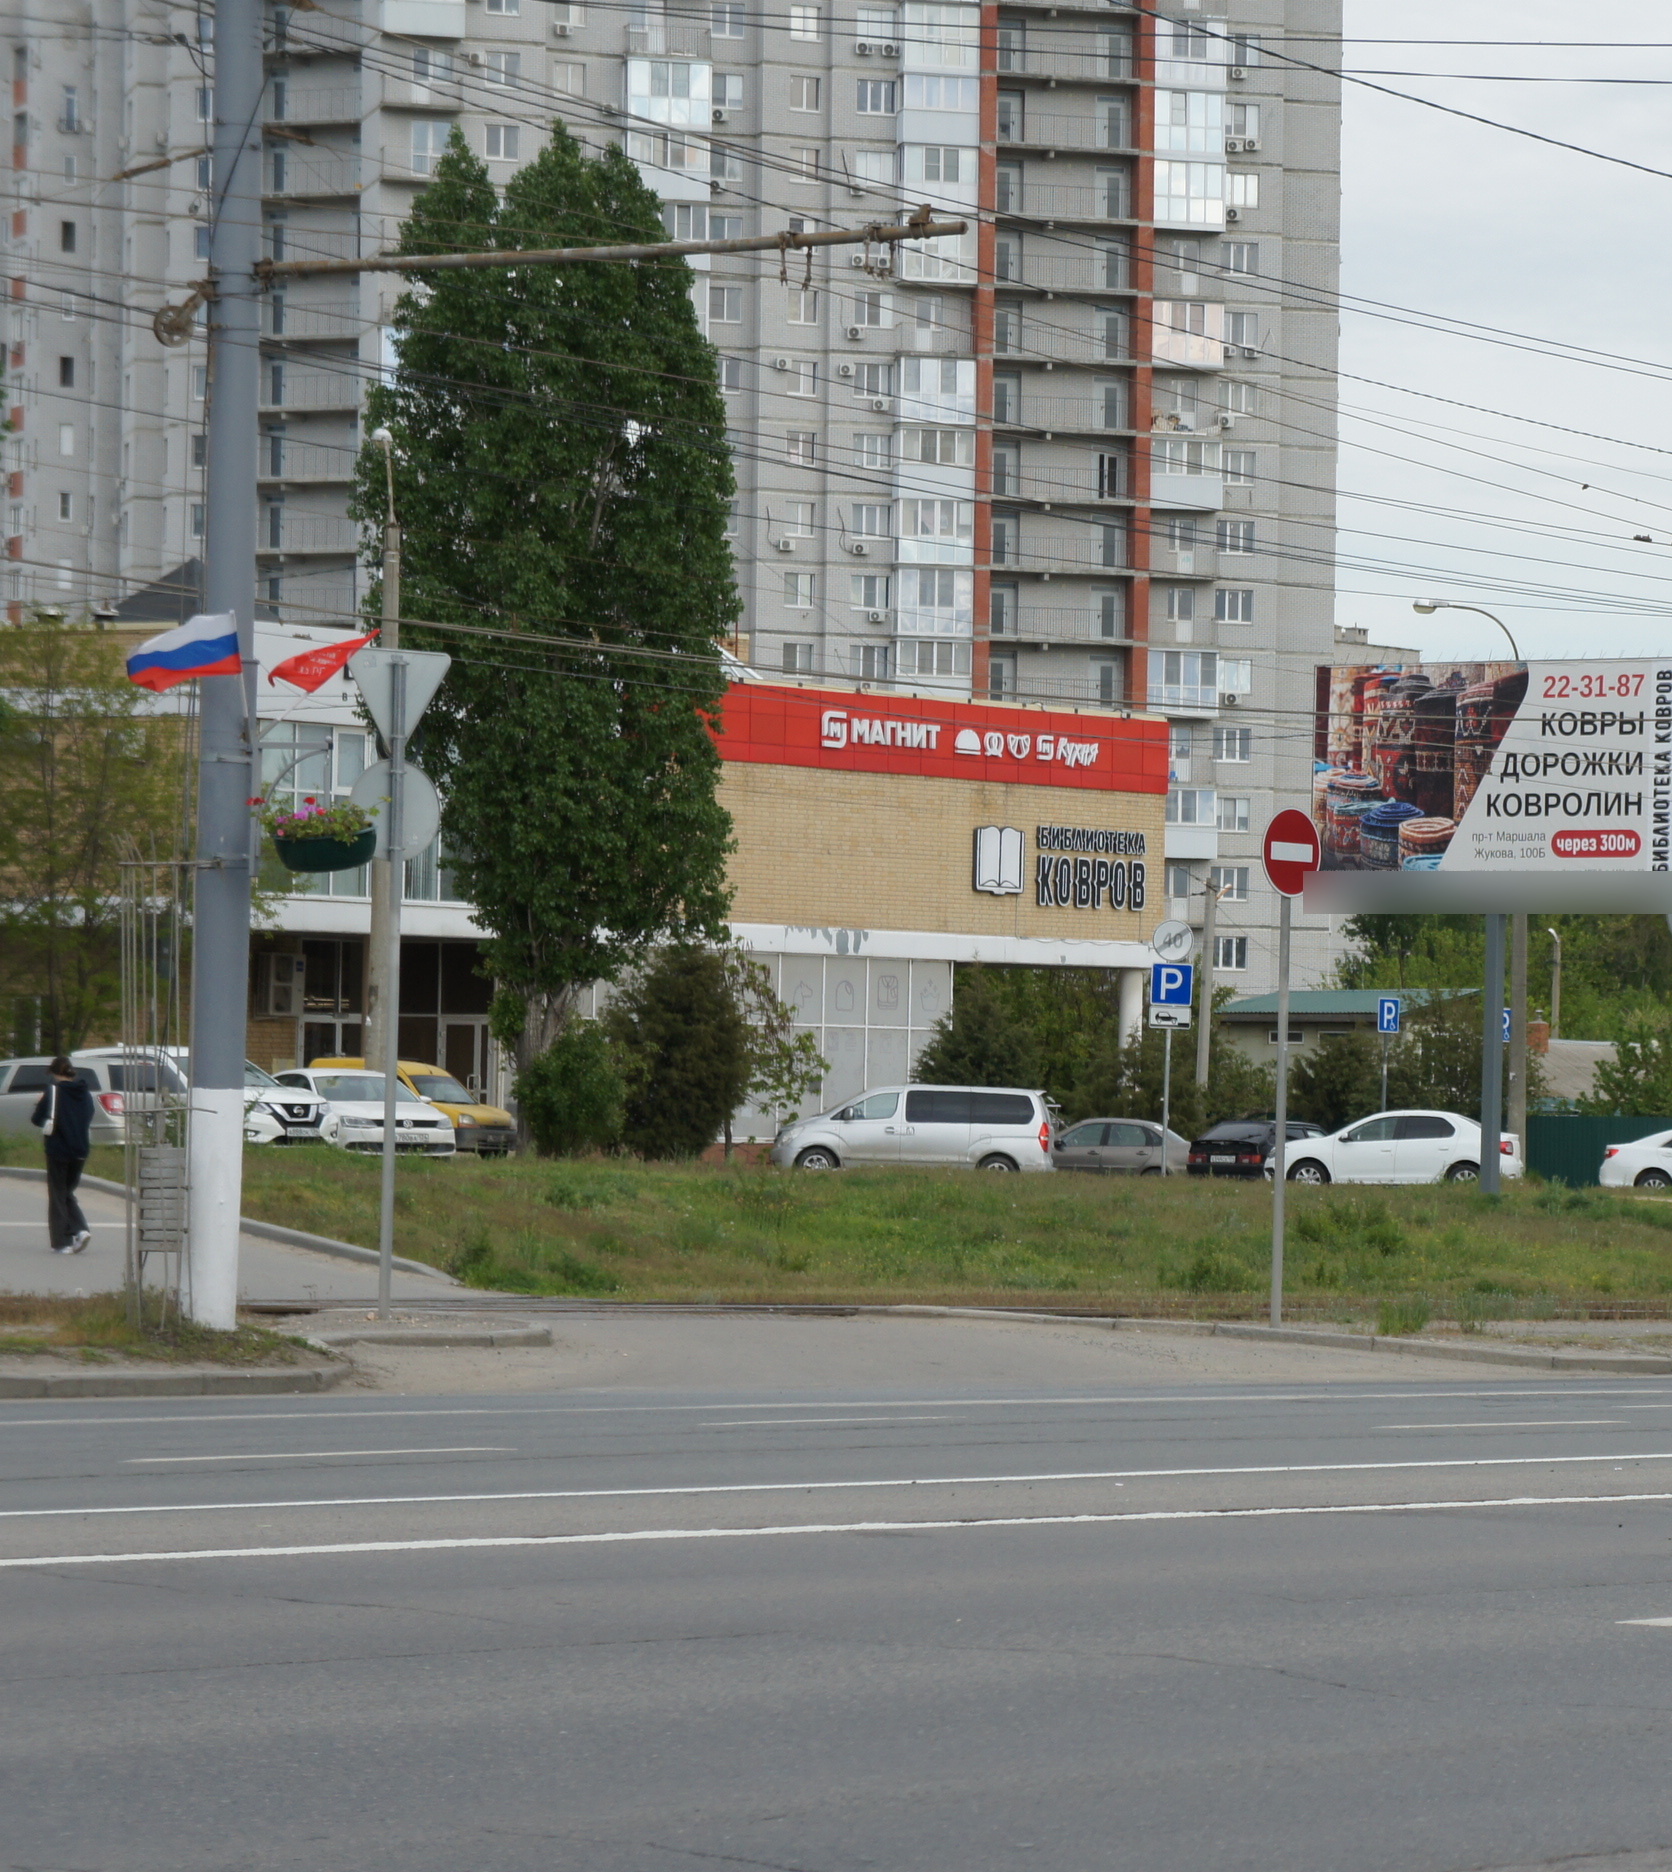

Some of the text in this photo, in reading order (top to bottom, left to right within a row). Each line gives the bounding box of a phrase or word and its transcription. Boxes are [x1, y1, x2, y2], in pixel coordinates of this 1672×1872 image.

[1542, 674, 1645, 698] 22-31-87
[1655, 669, 1672, 744] КОВРОВ
[850, 718, 941, 750] МАГНИТ
[1541, 711, 1644, 736] КОВРЫ
[1500, 752, 1643, 783] ДОРОЖКИ
[1486, 791, 1642, 817] КОВРОЛИН
[1037, 825, 1147, 855] БИБЛИОТЕКА
[1472, 831, 1546, 844] пр-т Маршала
[1556, 834, 1636, 855] через 300м
[1474, 847, 1546, 861] Жукова, 100Б
[1036, 855, 1147, 911] КОВРОВ
[1163, 932, 1183, 948] 40
[1160, 967, 1183, 1000] P
[1384, 1002, 1396, 1029] P
